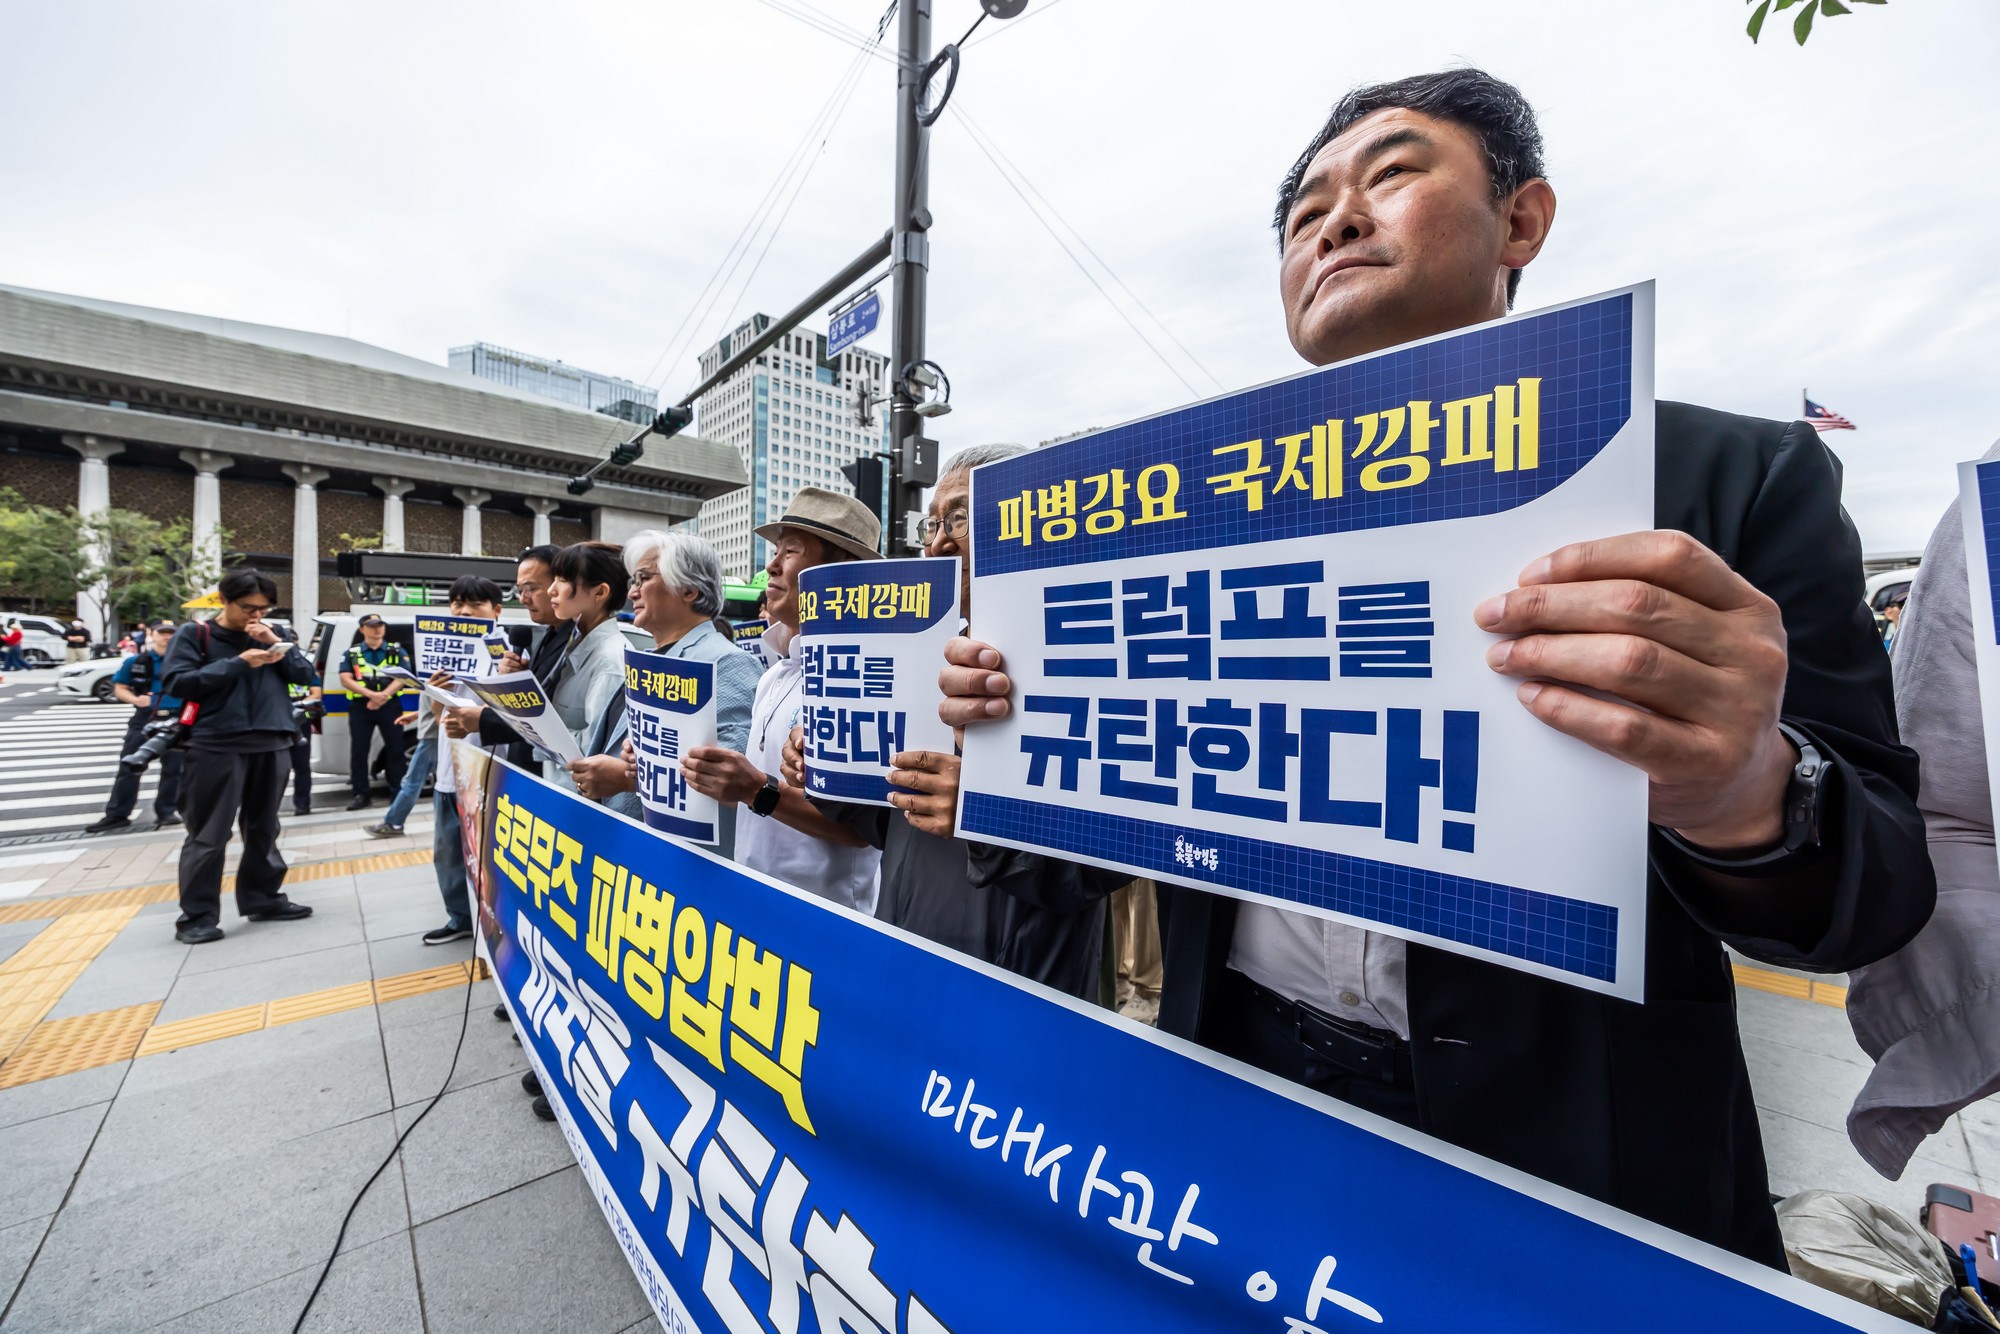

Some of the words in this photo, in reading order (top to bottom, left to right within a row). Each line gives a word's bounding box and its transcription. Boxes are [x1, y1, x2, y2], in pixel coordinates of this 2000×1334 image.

[829, 325, 867, 354] Sambong-ro
[830, 312, 857, 340] 삼봉로
[997, 462, 1188, 546] 파병강요
[1206, 377, 1543, 512] 국제깡패
[823, 582, 932, 620] 국제깡패
[1042, 559, 1435, 681] 트럼프를
[422, 654, 477, 673] 규탄한다!
[424, 637, 475, 655] 트럼프를
[801, 644, 895, 699] 럼프를
[641, 669, 698, 706] 국제깡패
[627, 706, 679, 759] 럼프를
[1020, 694, 1481, 853] 규탄한다!
[1175, 836, 1219, 871] 촛불행동
[493, 793, 584, 942] 호르무즈
[585, 854, 821, 1137] 파병압박
[516, 908, 632, 1152] 미국을
[920, 1069, 1220, 1286] 미대사관
